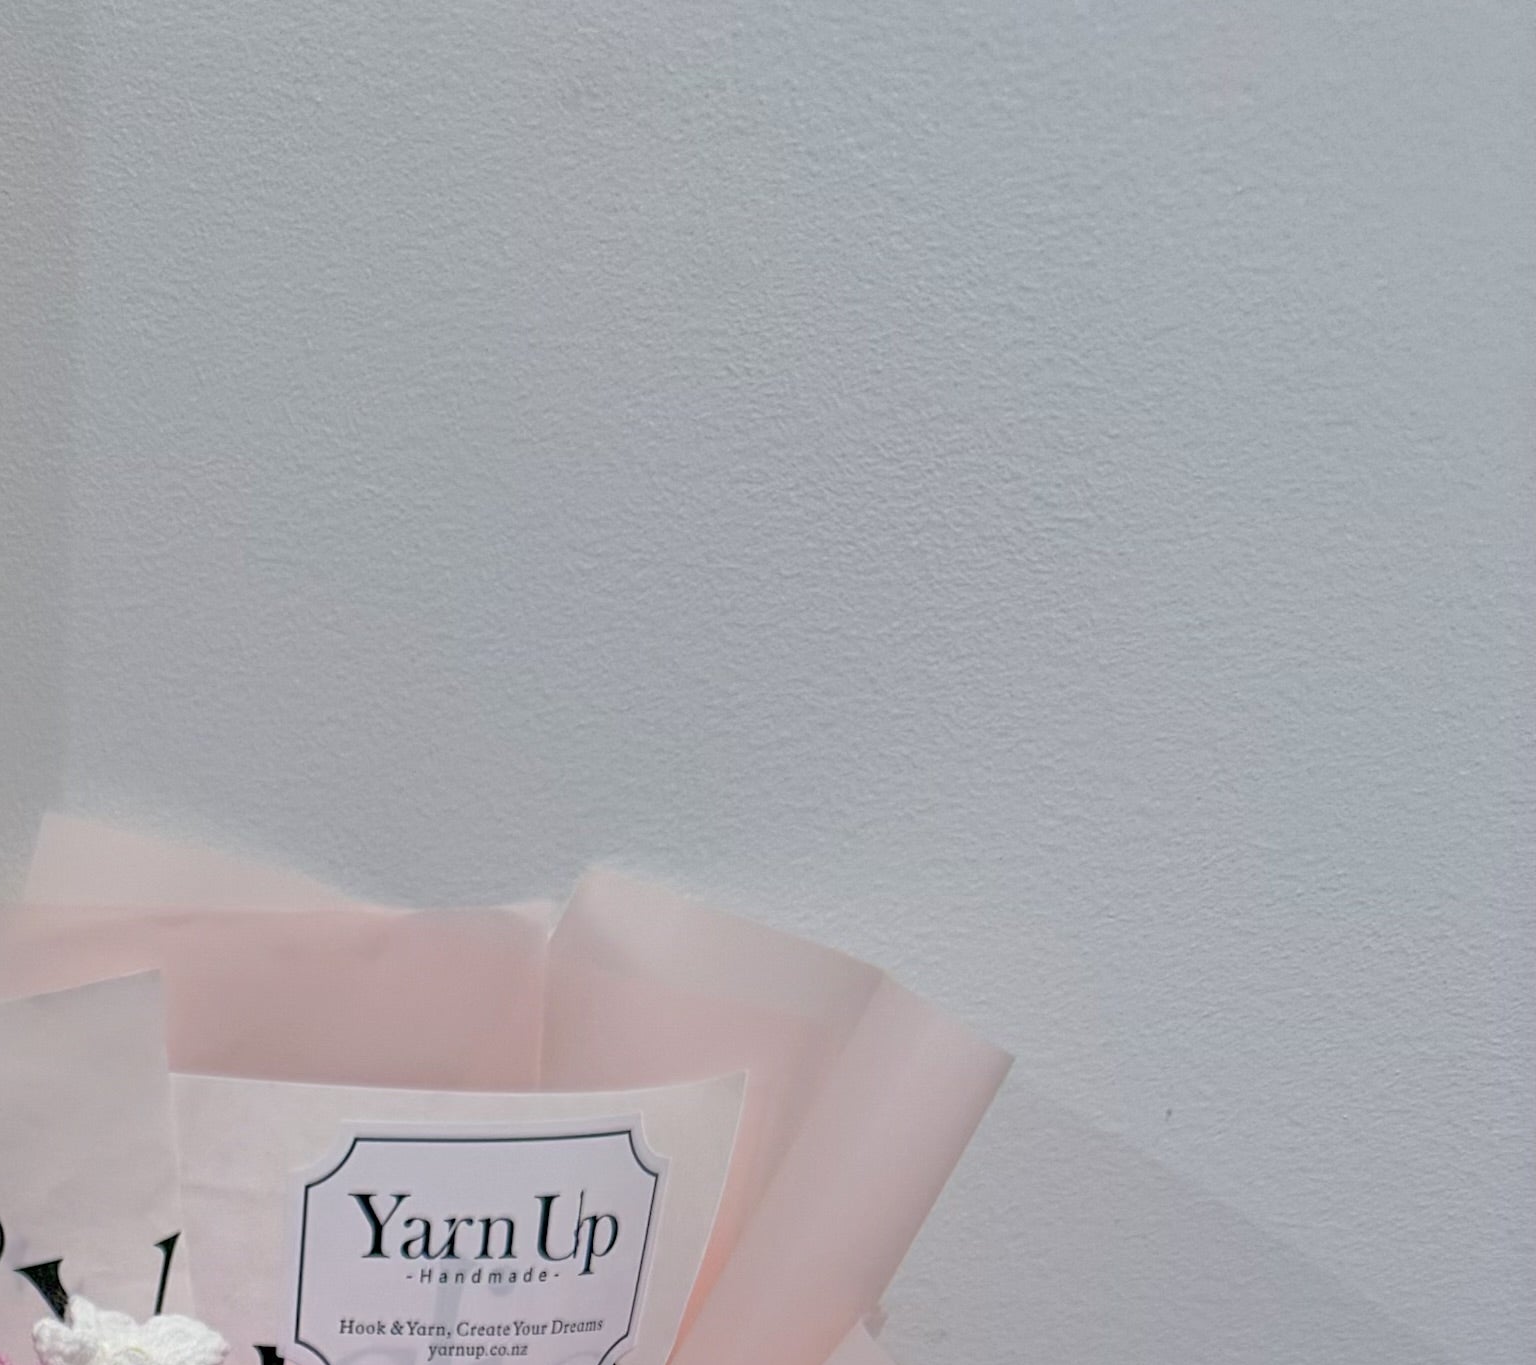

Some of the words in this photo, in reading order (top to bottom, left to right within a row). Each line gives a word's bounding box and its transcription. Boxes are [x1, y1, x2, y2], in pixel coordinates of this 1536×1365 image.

[348, 1192, 518, 1261] Yarn
[533, 1189, 620, 1277] Up
[338, 1318, 387, 1336] Hook
[390, 1319, 405, 1336] &
[406, 1321, 452, 1339] Yarn,
[456, 1321, 511, 1338] Create
[512, 1320, 549, 1336] Your
[550, 1317, 604, 1335] Dreams
[427, 1343, 529, 1362] yarnup.co.nz
